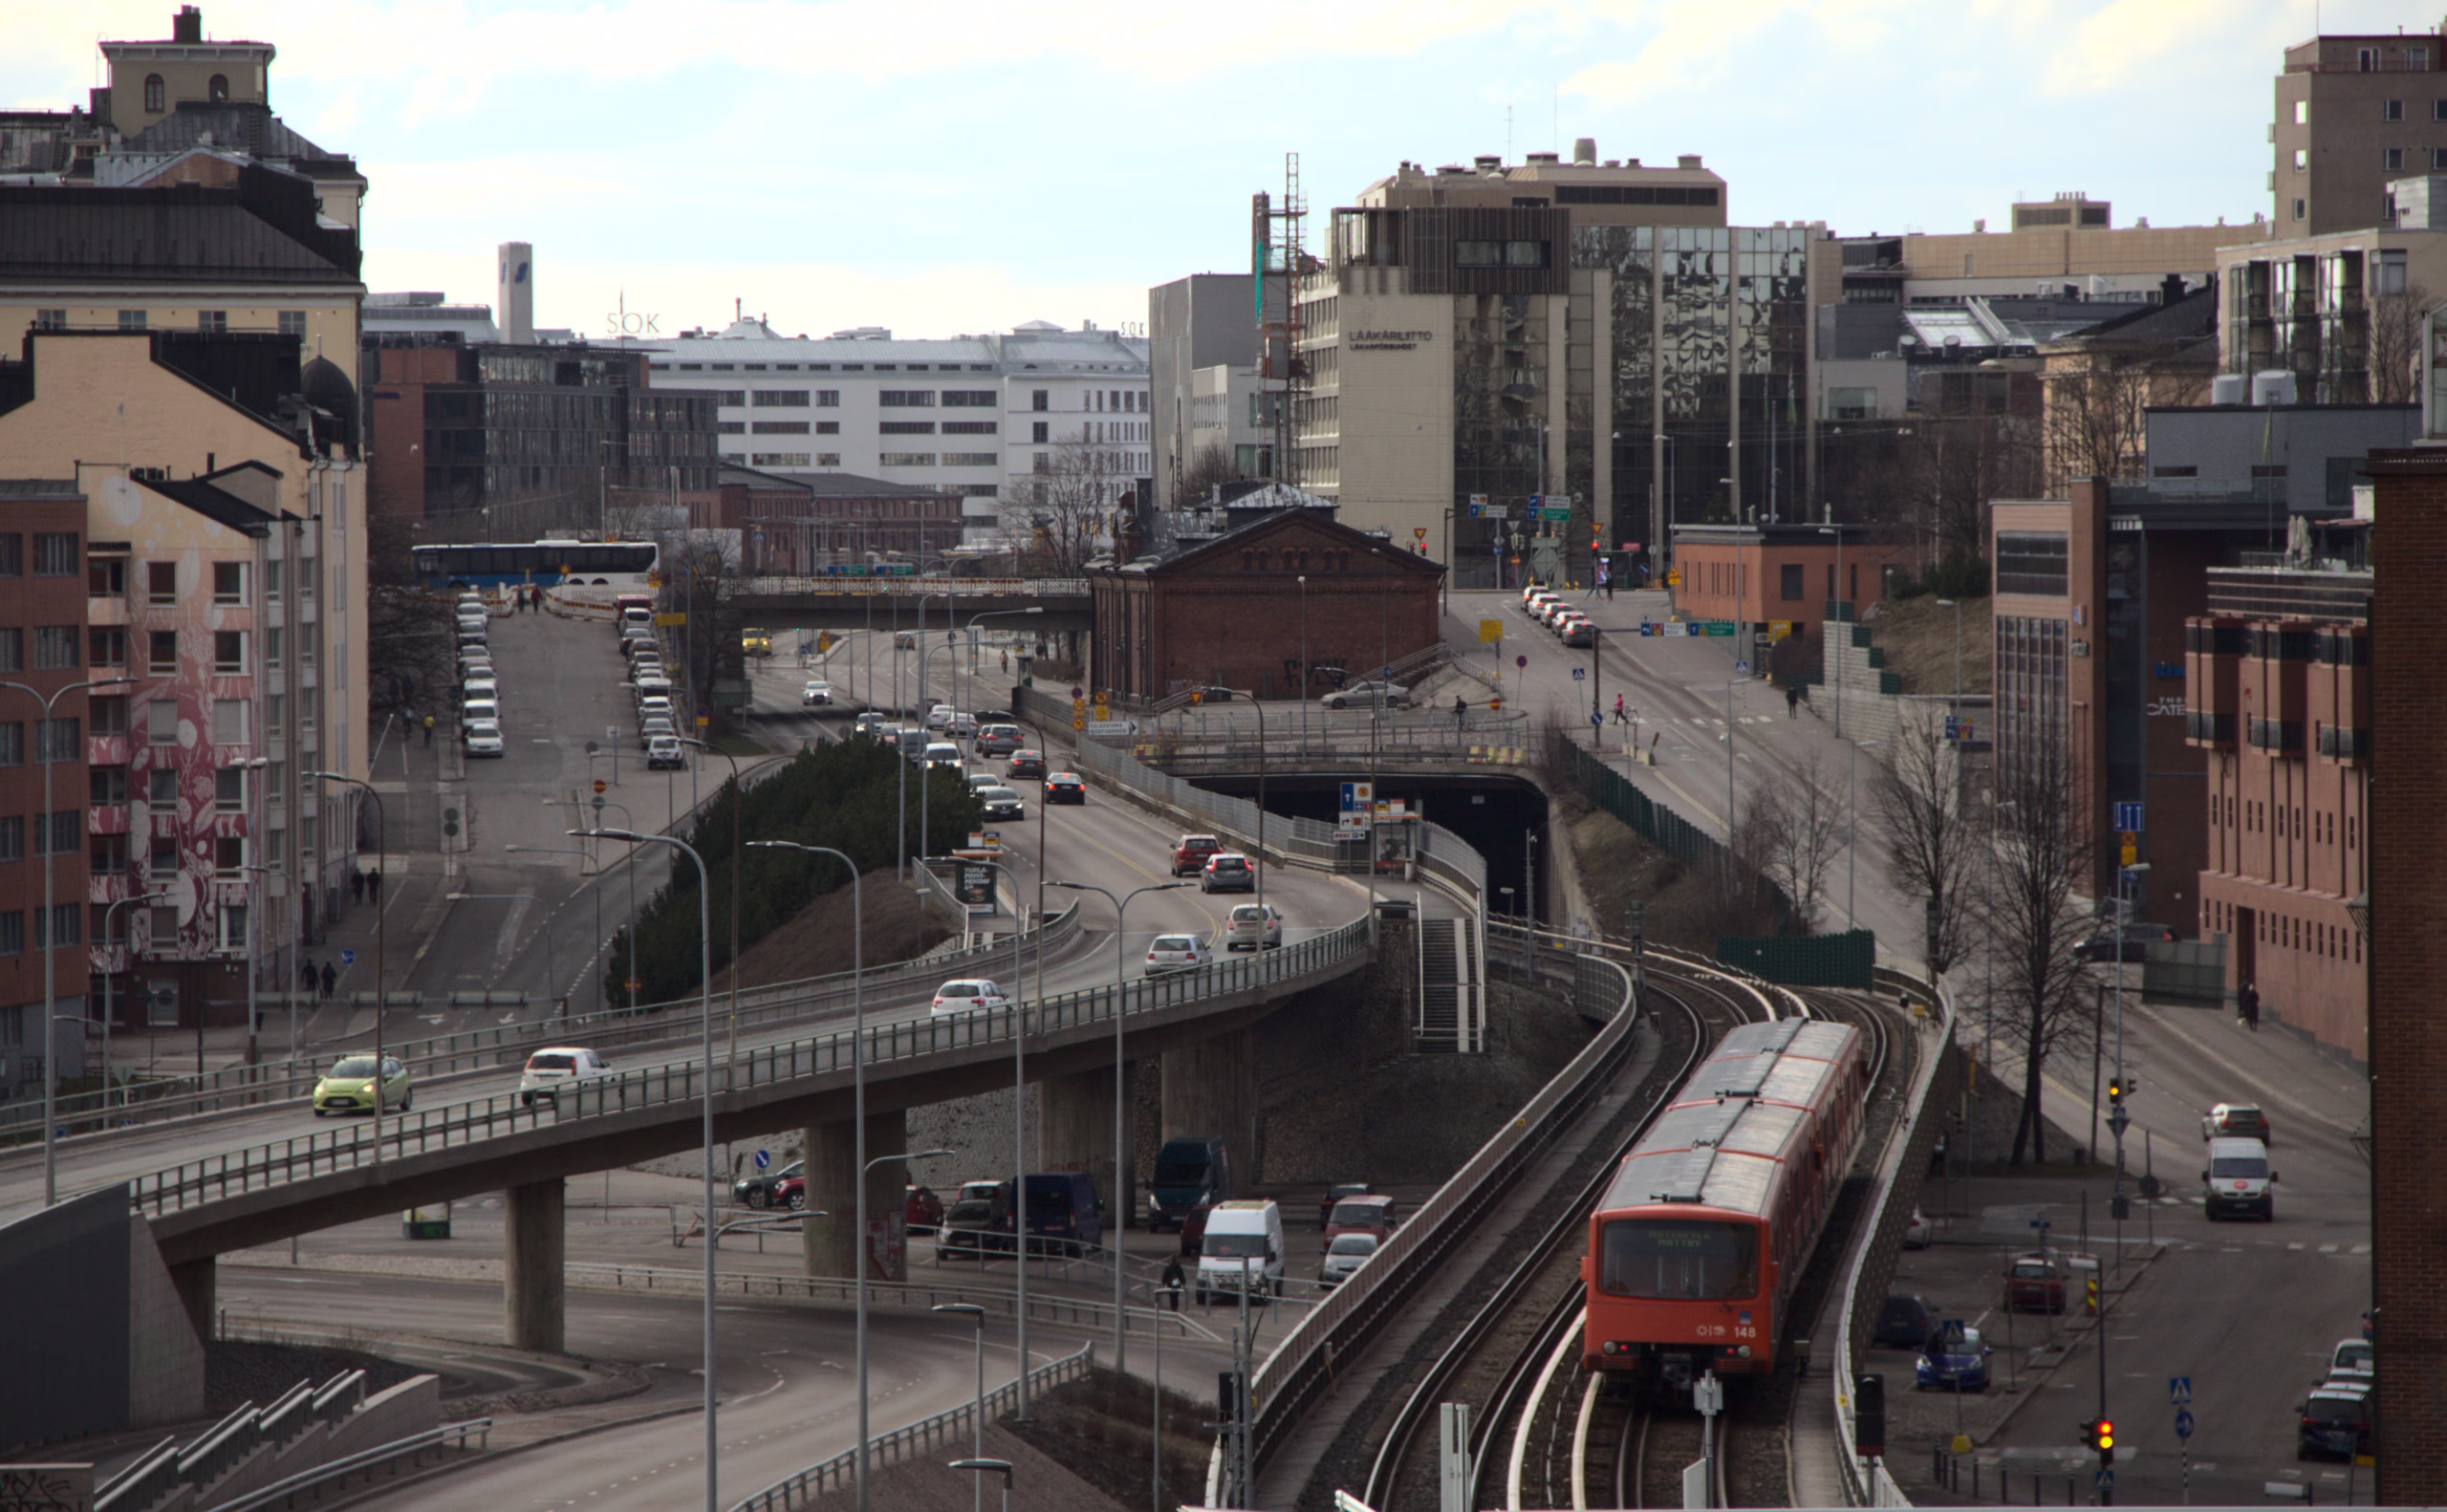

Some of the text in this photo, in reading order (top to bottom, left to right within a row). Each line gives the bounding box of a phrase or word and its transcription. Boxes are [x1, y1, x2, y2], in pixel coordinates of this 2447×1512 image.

[607, 313, 660, 334] SOK
[1349, 330, 1432, 341] LÄÄKÄRILIITTO
[1658, 1239, 1702, 1248] MATTBY
[1734, 1327, 1756, 1339] 148
